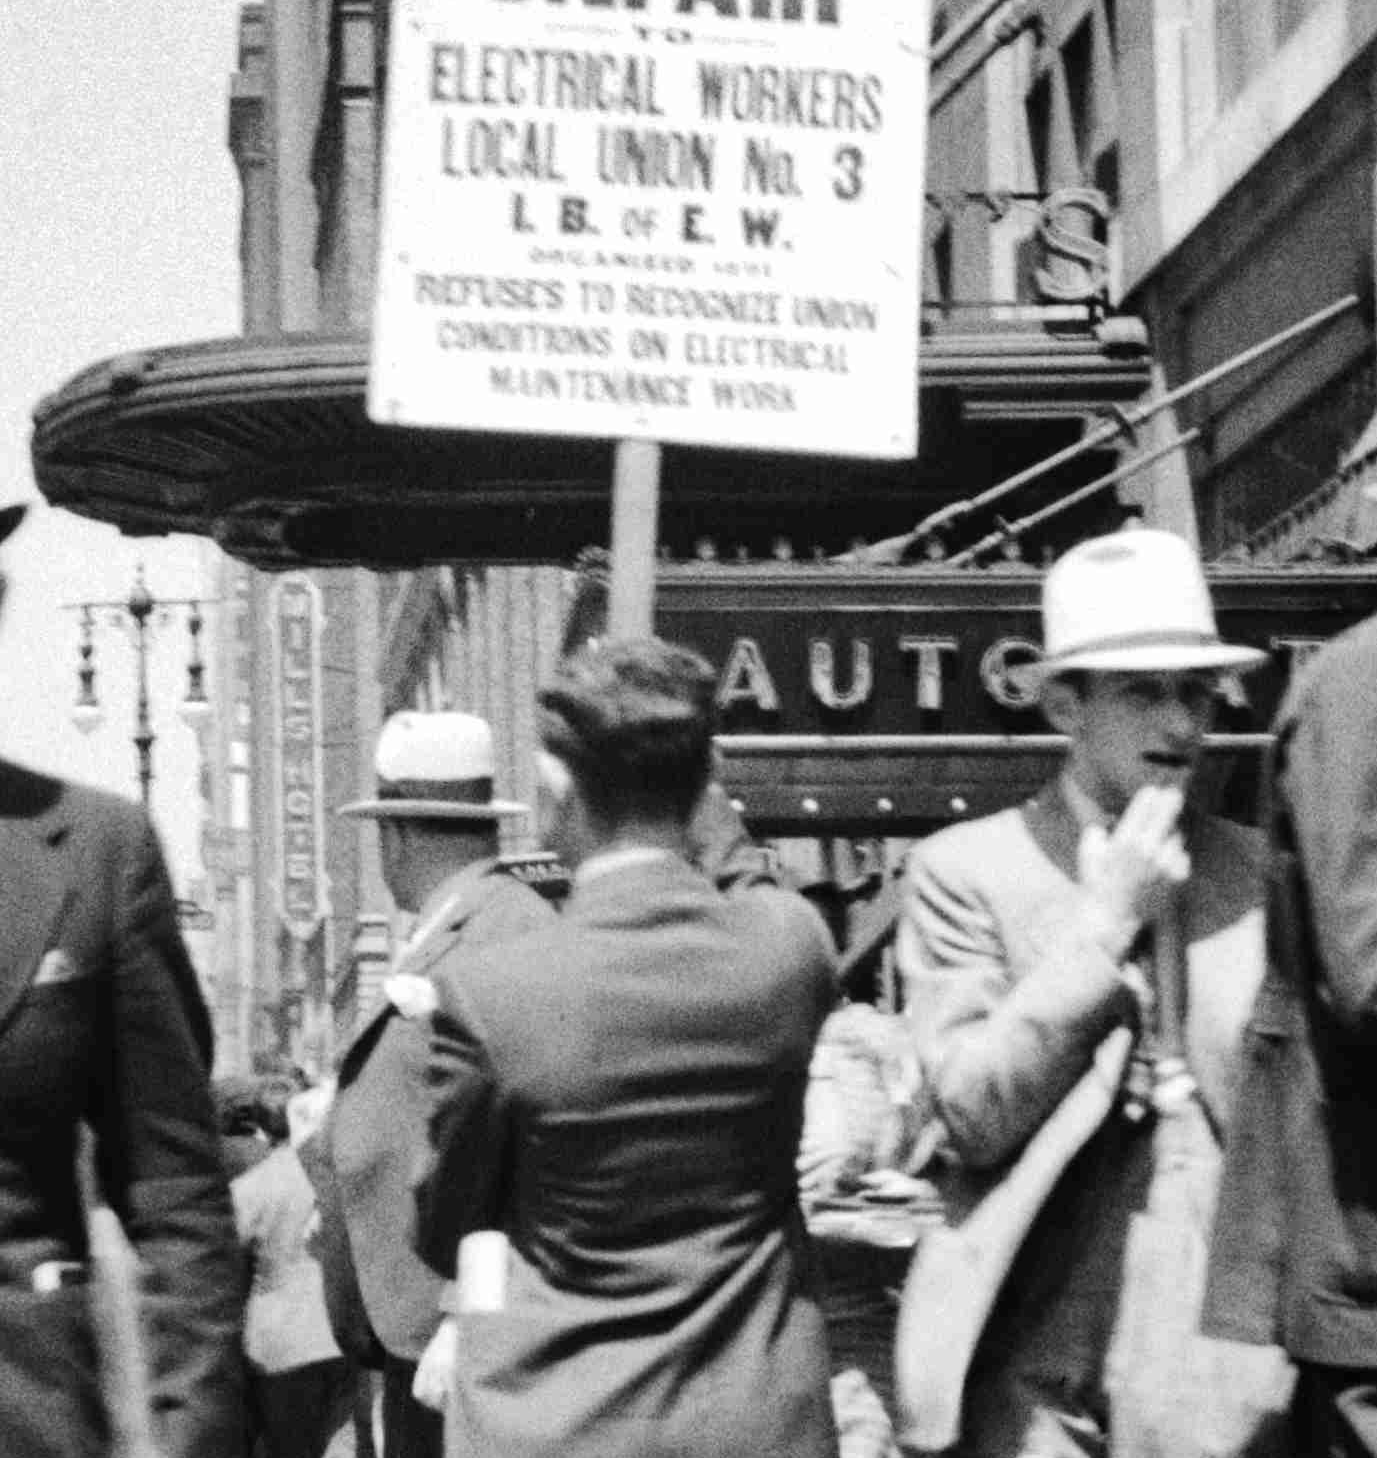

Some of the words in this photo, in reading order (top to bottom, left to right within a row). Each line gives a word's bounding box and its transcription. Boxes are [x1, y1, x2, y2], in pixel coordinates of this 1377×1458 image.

[631, 21, 691, 46] TO
[427, 43, 664, 118] ELECTRICAL
[697, 58, 884, 134] WORKERS
[441, 117, 566, 186] LOCAL
[598, 124, 716, 194] UNION
[832, 143, 866, 203] 3
[558, 195, 600, 236] B.
[680, 202, 716, 244] E.
[741, 207, 793, 252] W.
[414, 272, 565, 313] REFUSES
[579, 280, 616, 316] TO
[623, 282, 781, 328] RECOGNIZE
[792, 294, 877, 334] UNION
[436, 318, 614, 362] CONDITIONS
[630, 326, 669, 363] ON
[683, 330, 850, 376] ELECTRICAL
[489, 363, 693, 409] MAINTENANCE
[712, 372, 798, 414] WORK
